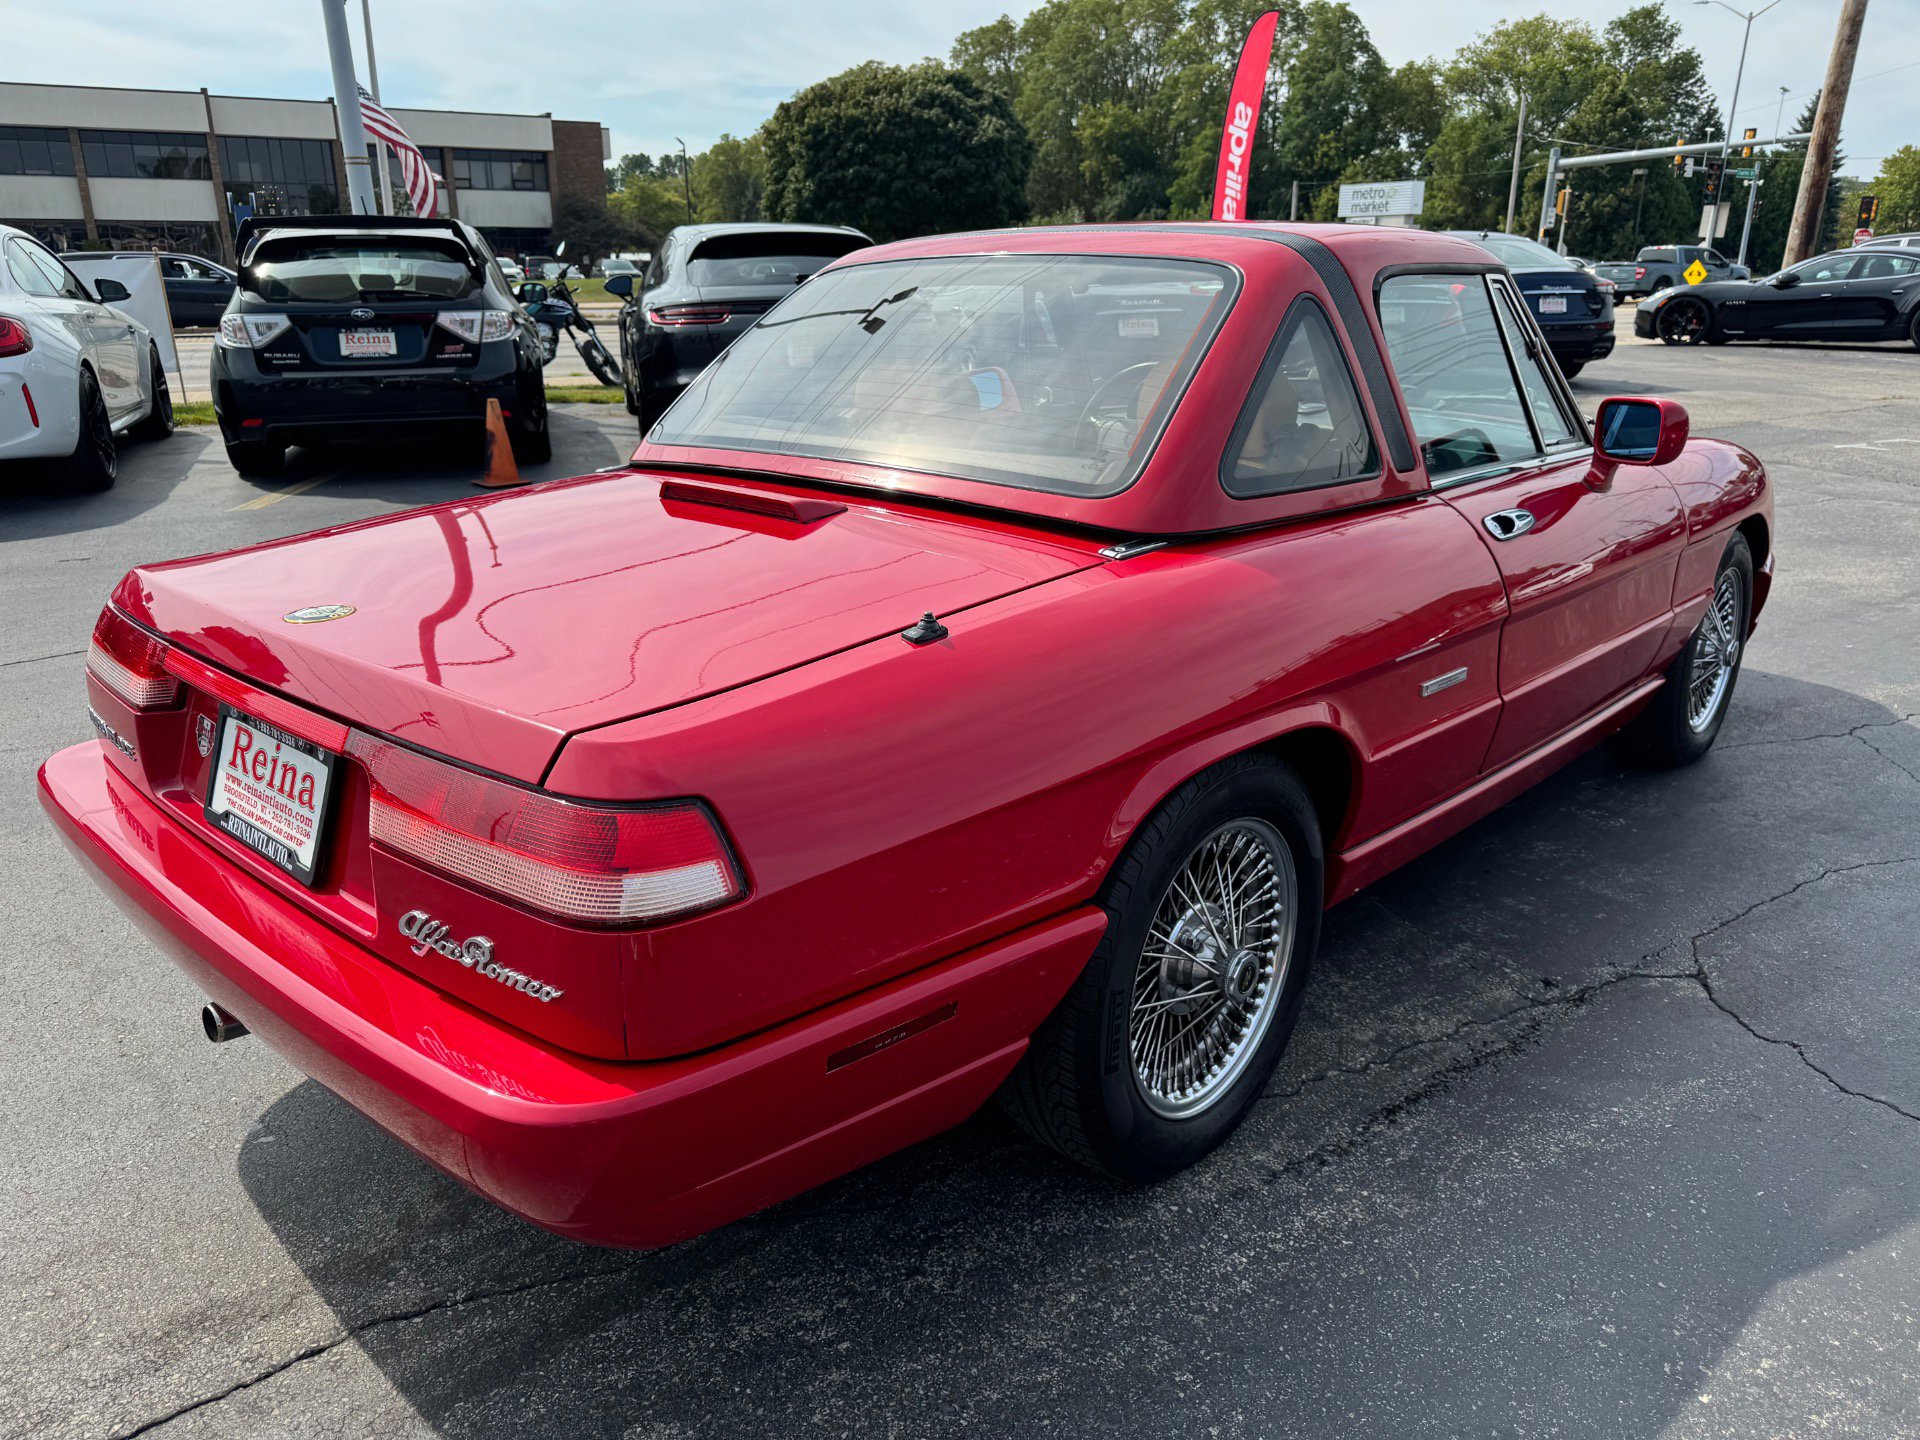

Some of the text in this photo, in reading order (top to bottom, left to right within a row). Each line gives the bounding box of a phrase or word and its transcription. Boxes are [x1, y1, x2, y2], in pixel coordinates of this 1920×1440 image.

[1222, 101, 1253, 220] aprilia
[1351, 200, 1389, 213] market
[1352, 187, 1386, 200] metro
[344, 331, 391, 345] Reina
[228, 722, 315, 813] Reina
[225, 772, 313, 828] www.reinaintlauto.com
[236, 801, 254, 820] ITALIAN
[254, 813, 273, 831] SPORTS
